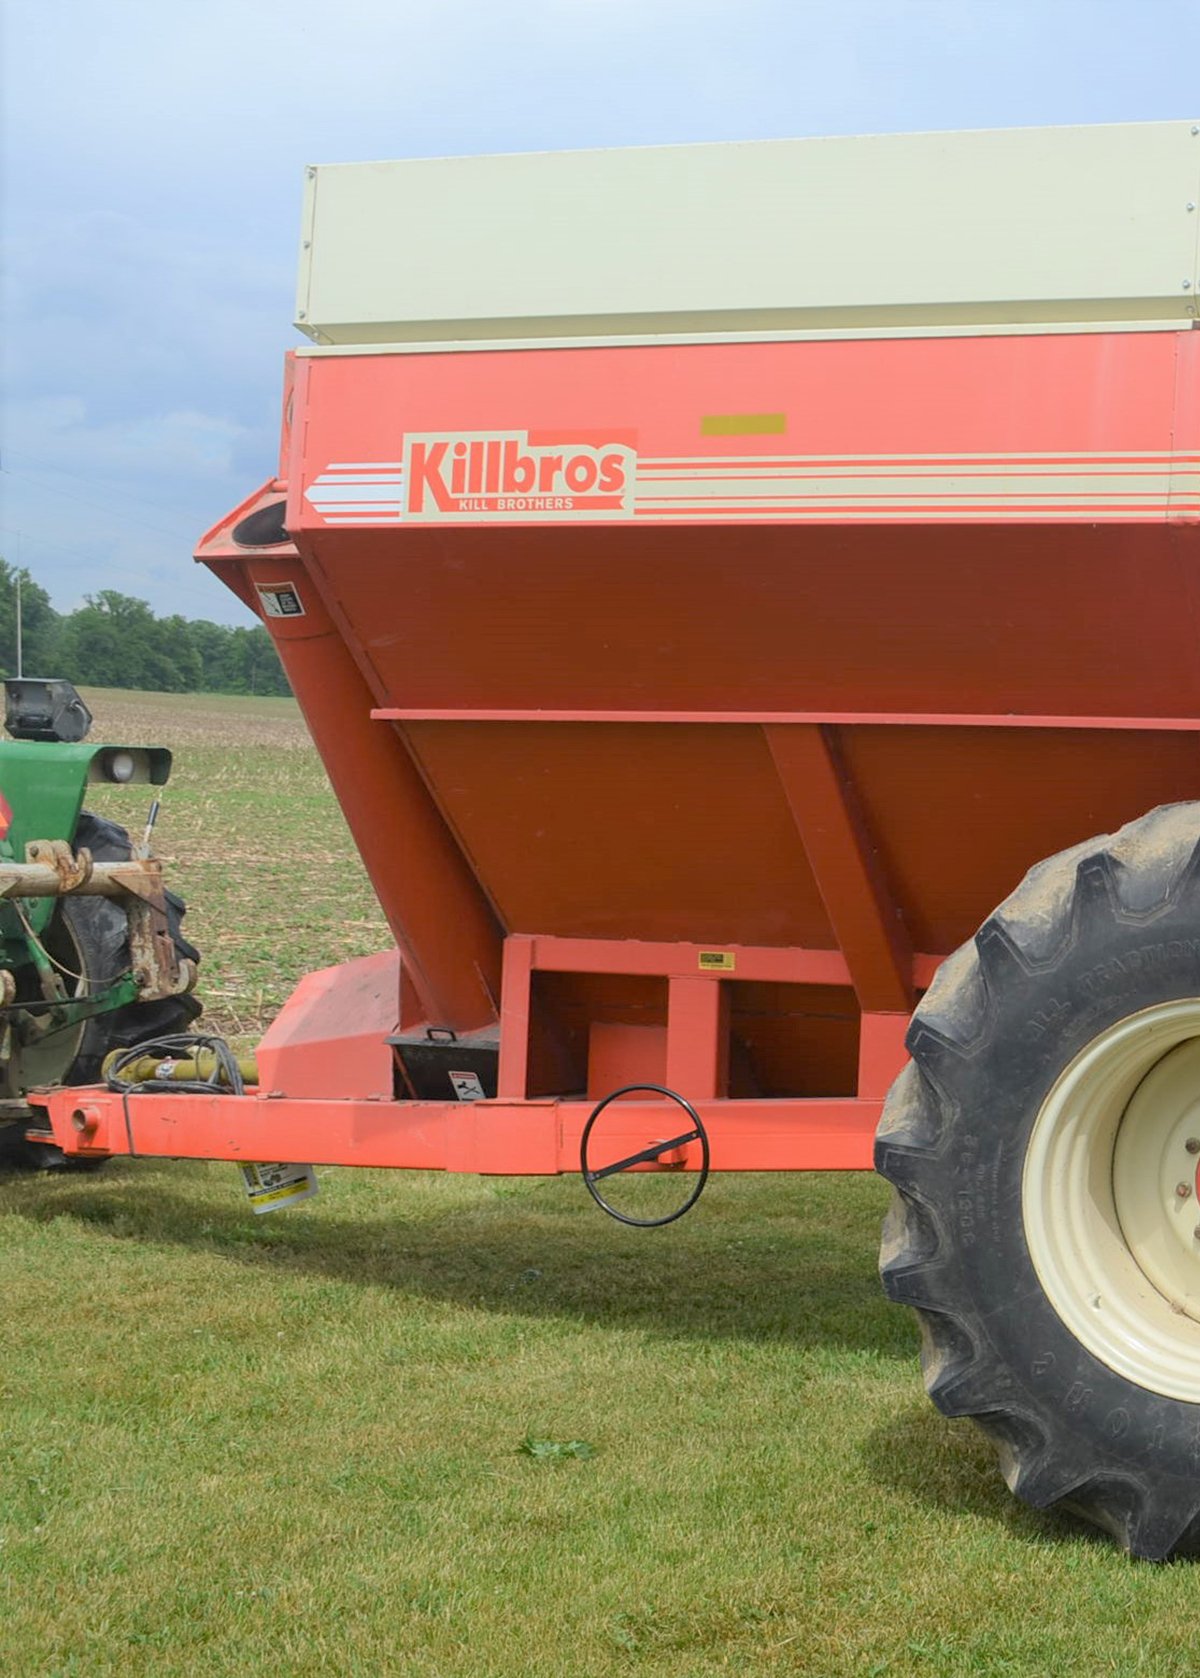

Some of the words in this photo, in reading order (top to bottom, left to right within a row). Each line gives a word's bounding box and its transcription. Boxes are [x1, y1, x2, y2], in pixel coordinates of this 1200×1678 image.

[408, 440, 625, 512] Killbros
[459, 499, 488, 510] KILL
[497, 497, 574, 510] BROTHERS
